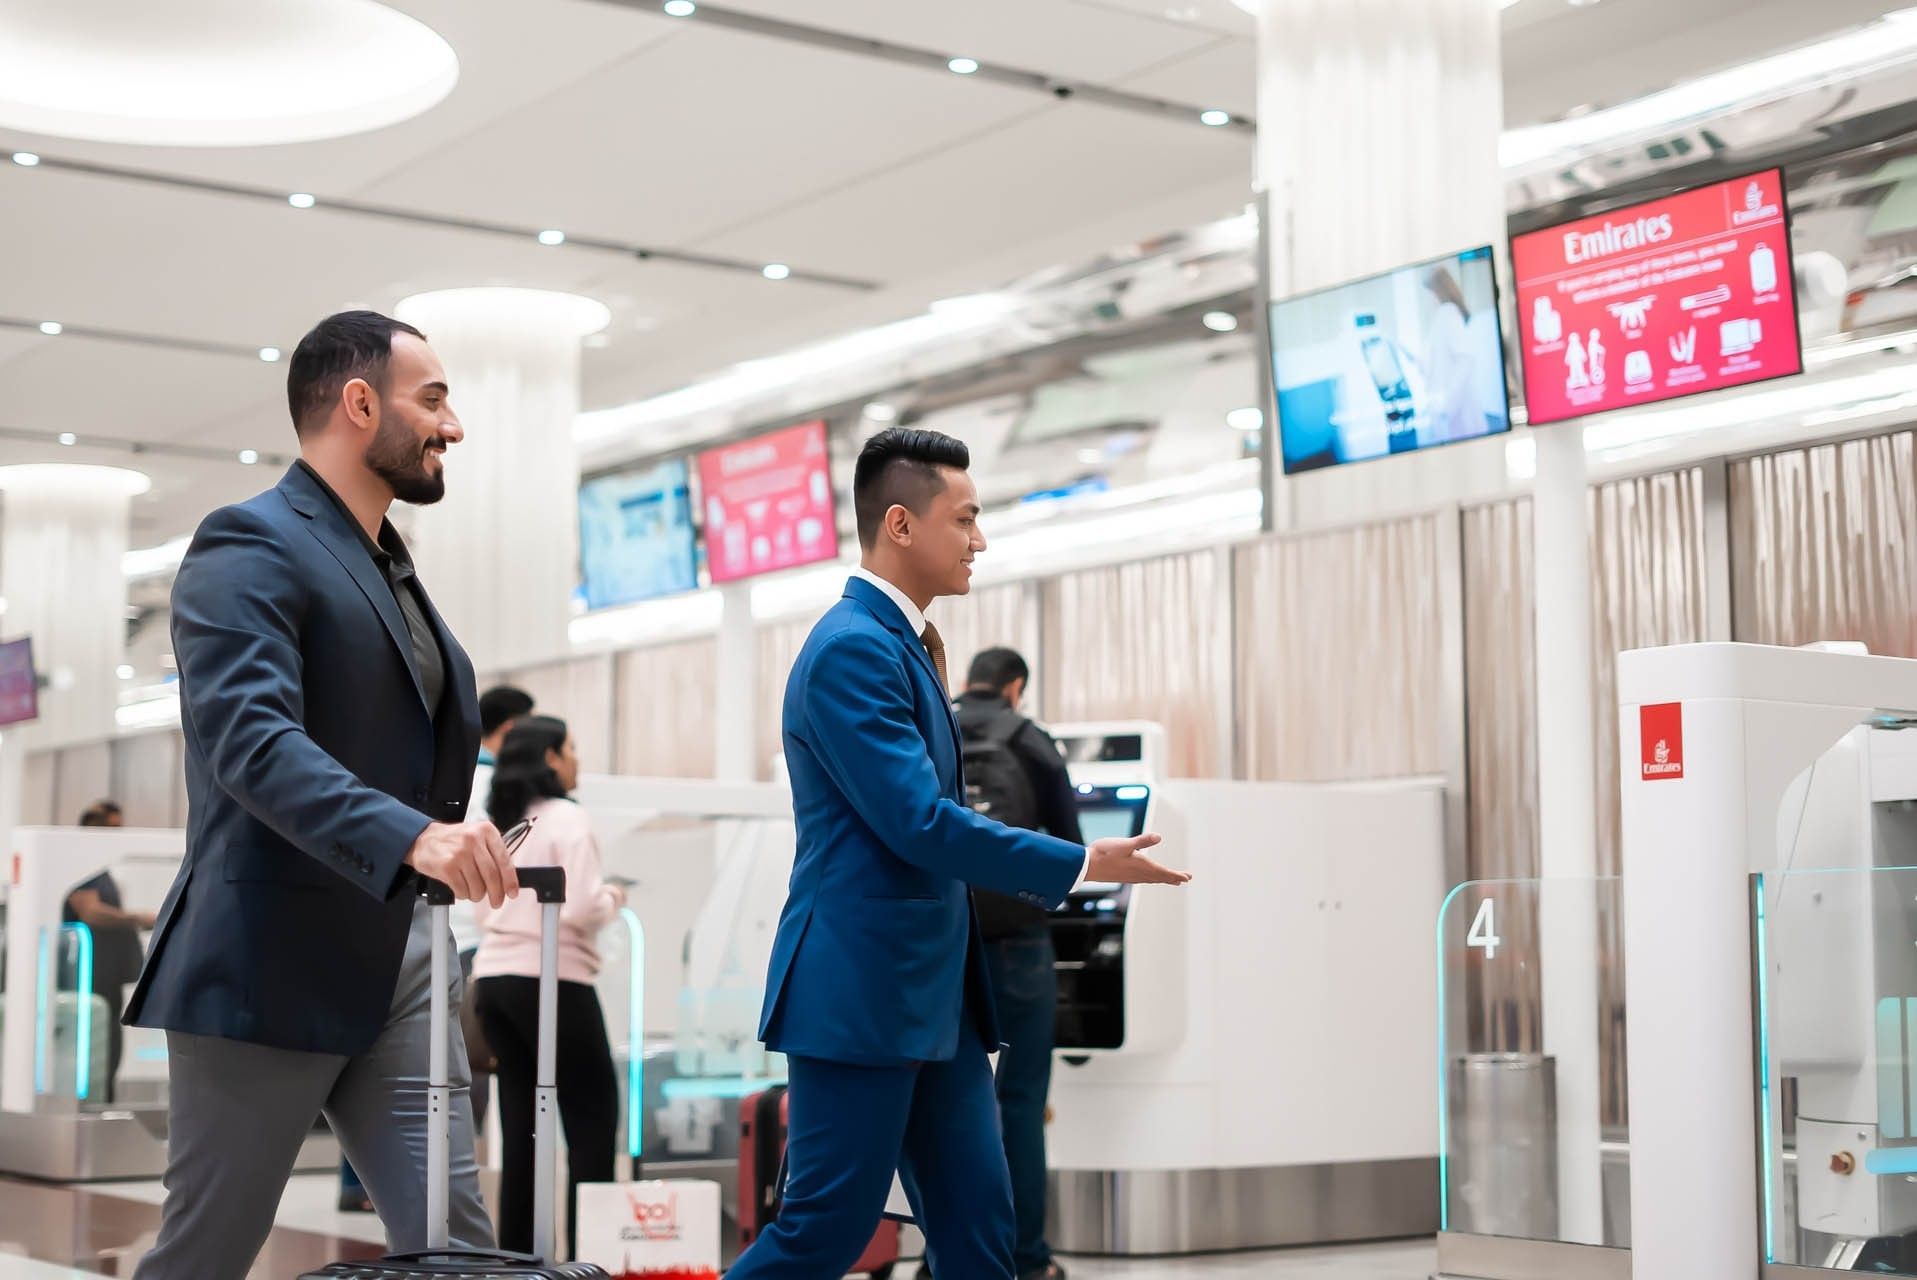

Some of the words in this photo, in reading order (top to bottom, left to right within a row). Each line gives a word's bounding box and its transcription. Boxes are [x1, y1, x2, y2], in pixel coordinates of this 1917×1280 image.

[1563, 213, 1673, 264] Emirates
[1643, 762, 1681, 774] Emirates
[1467, 898, 1500, 959] 4
